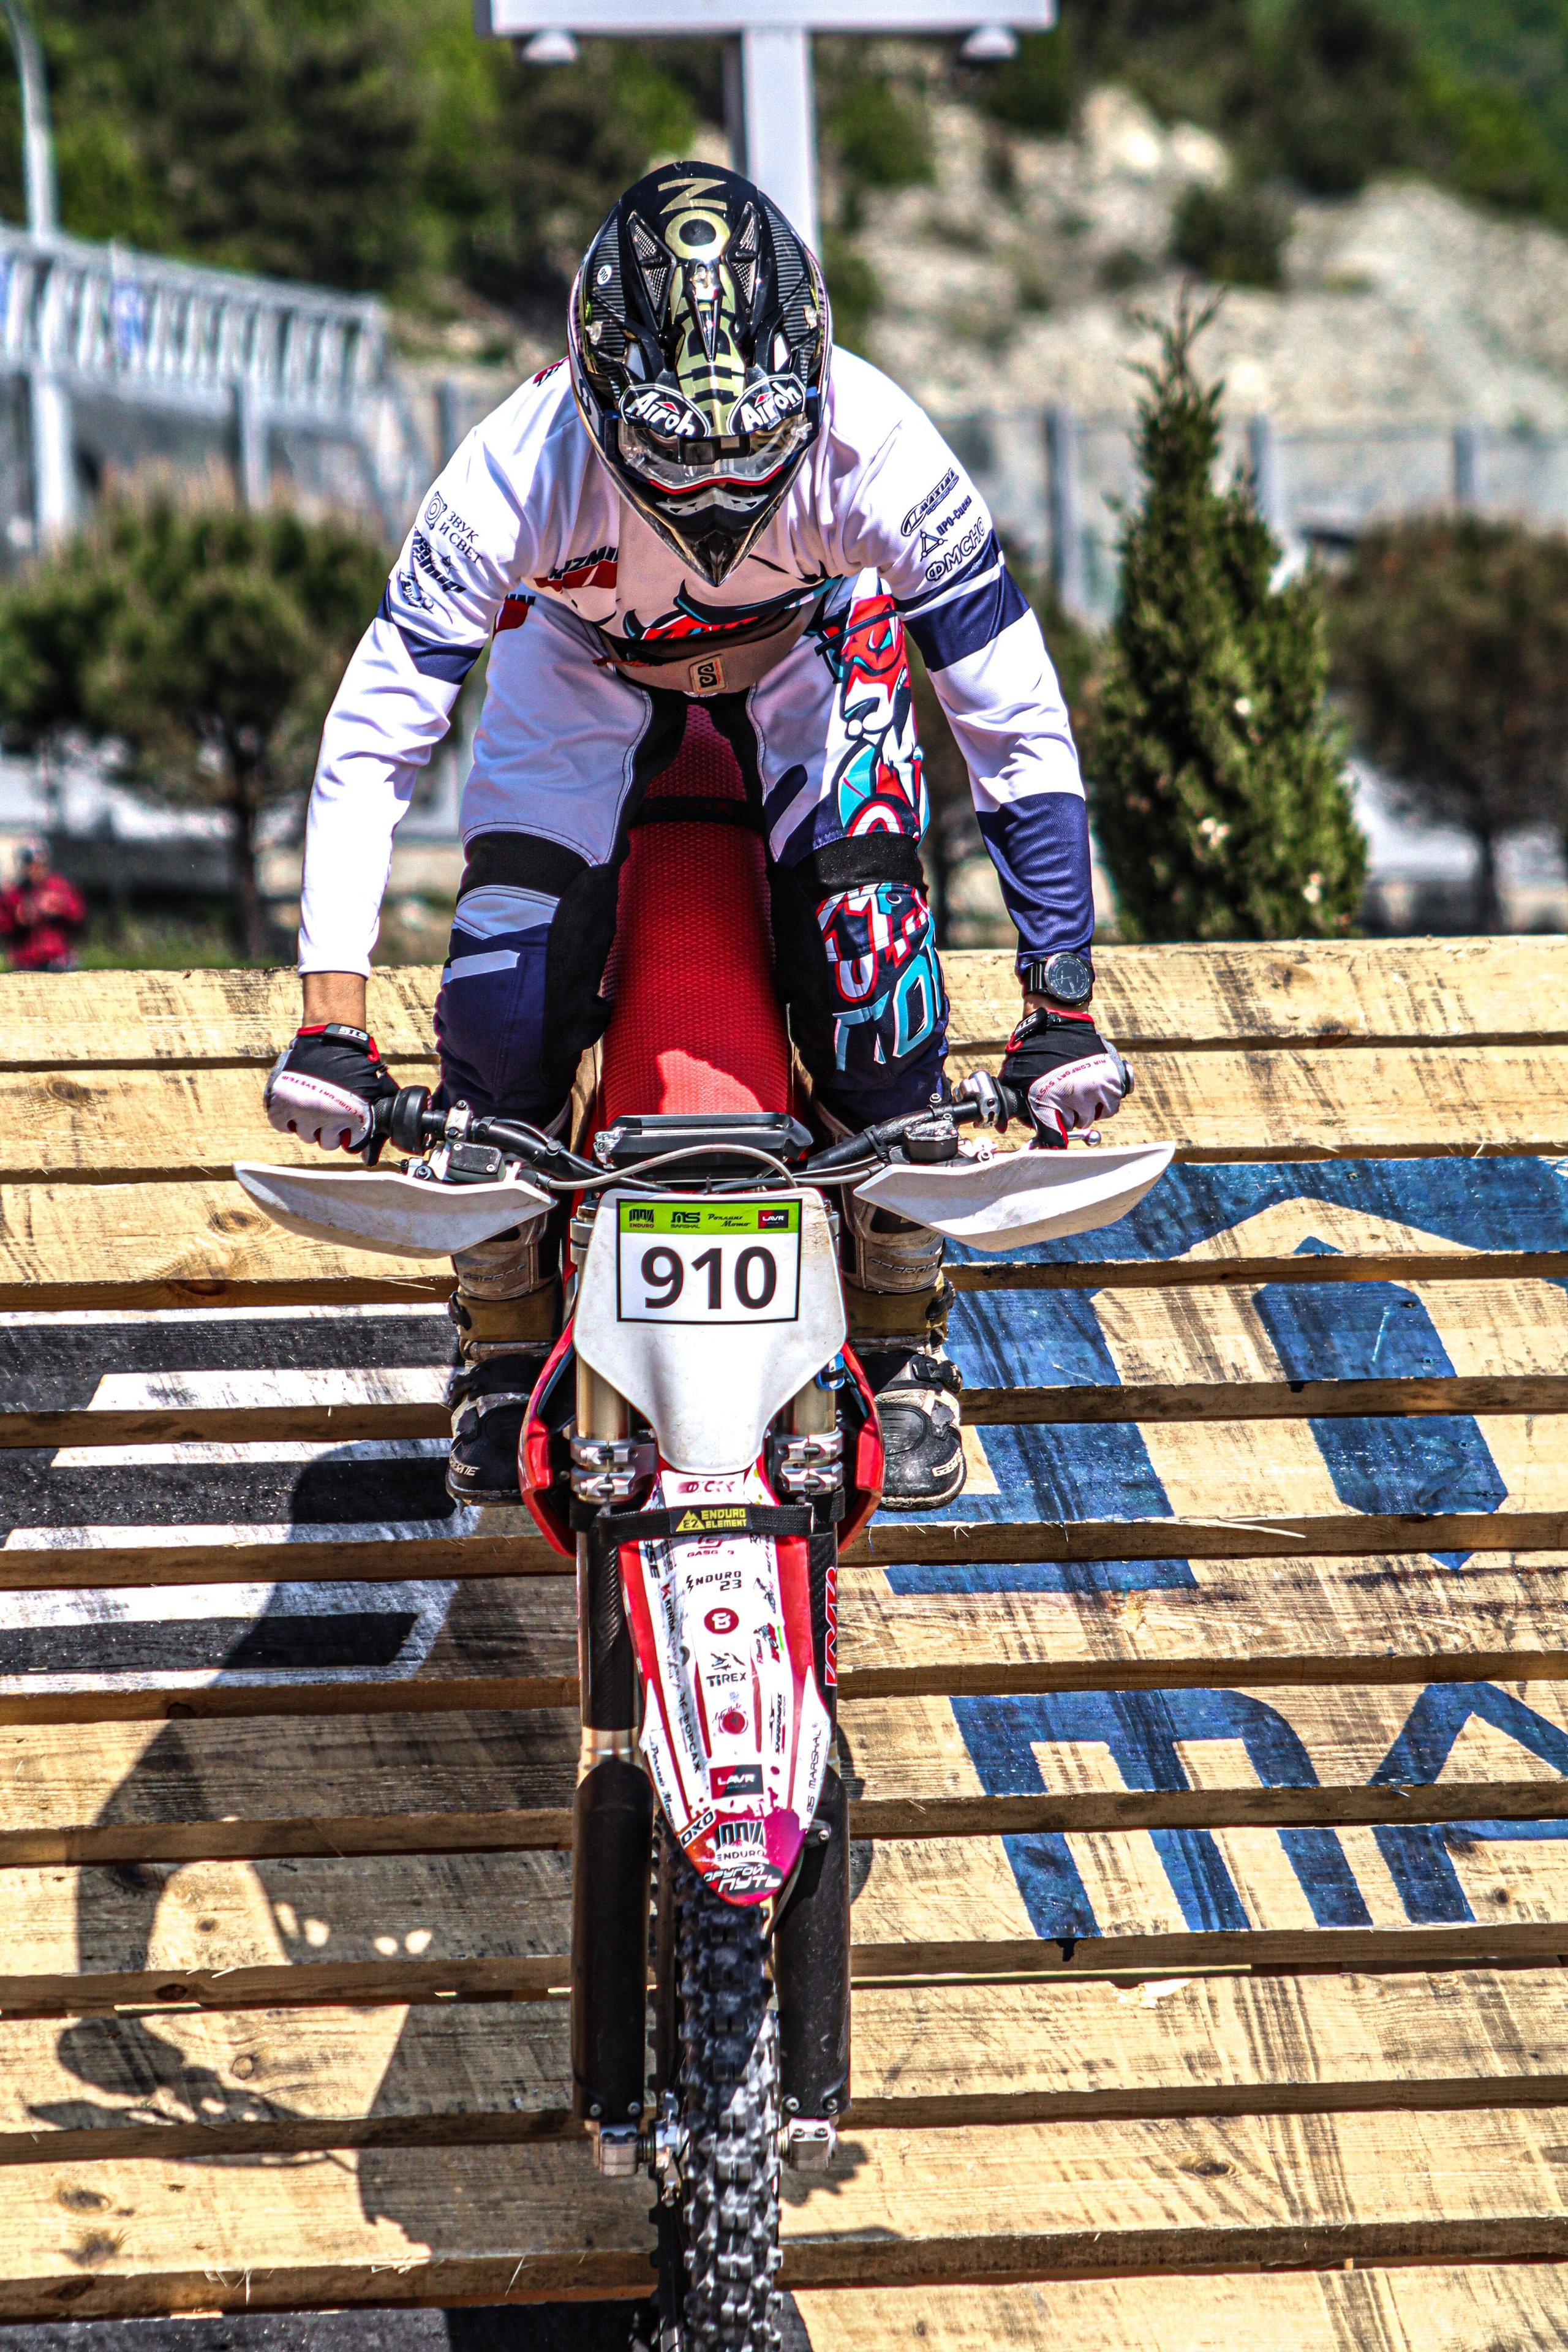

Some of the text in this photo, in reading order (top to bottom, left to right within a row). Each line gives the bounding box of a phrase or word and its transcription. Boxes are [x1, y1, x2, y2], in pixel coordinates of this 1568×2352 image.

[599, 268, 608, 281] 910
[625, 391, 696, 435] Airoh
[740, 381, 802, 431] Airoh
[446, 510, 479, 543] ЗВУК
[439, 522, 483, 564] И СВЕТ
[338, 1026, 368, 1041] STG
[1056, 1062, 1091, 1082] COMFORT
[281, 1076, 317, 1090] SYSTEM
[641, 1246, 777, 1310] 910
[701, 1508, 746, 1520] ENDURO
[705, 1519, 747, 1529] ELEMENT
[720, 1579, 742, 1591] 23
[663, 1599, 677, 1632] KENDA
[683, 1716, 701, 1774] ФОРСАЖ
[809, 1728, 821, 1789] MARSHAL
[717, 1774, 756, 1785] LAVR
[716, 1850, 765, 1861] ENDURO
[704, 1863, 765, 1882] ДРУГОЙ
[718, 1875, 782, 1893] ПУТЬ
